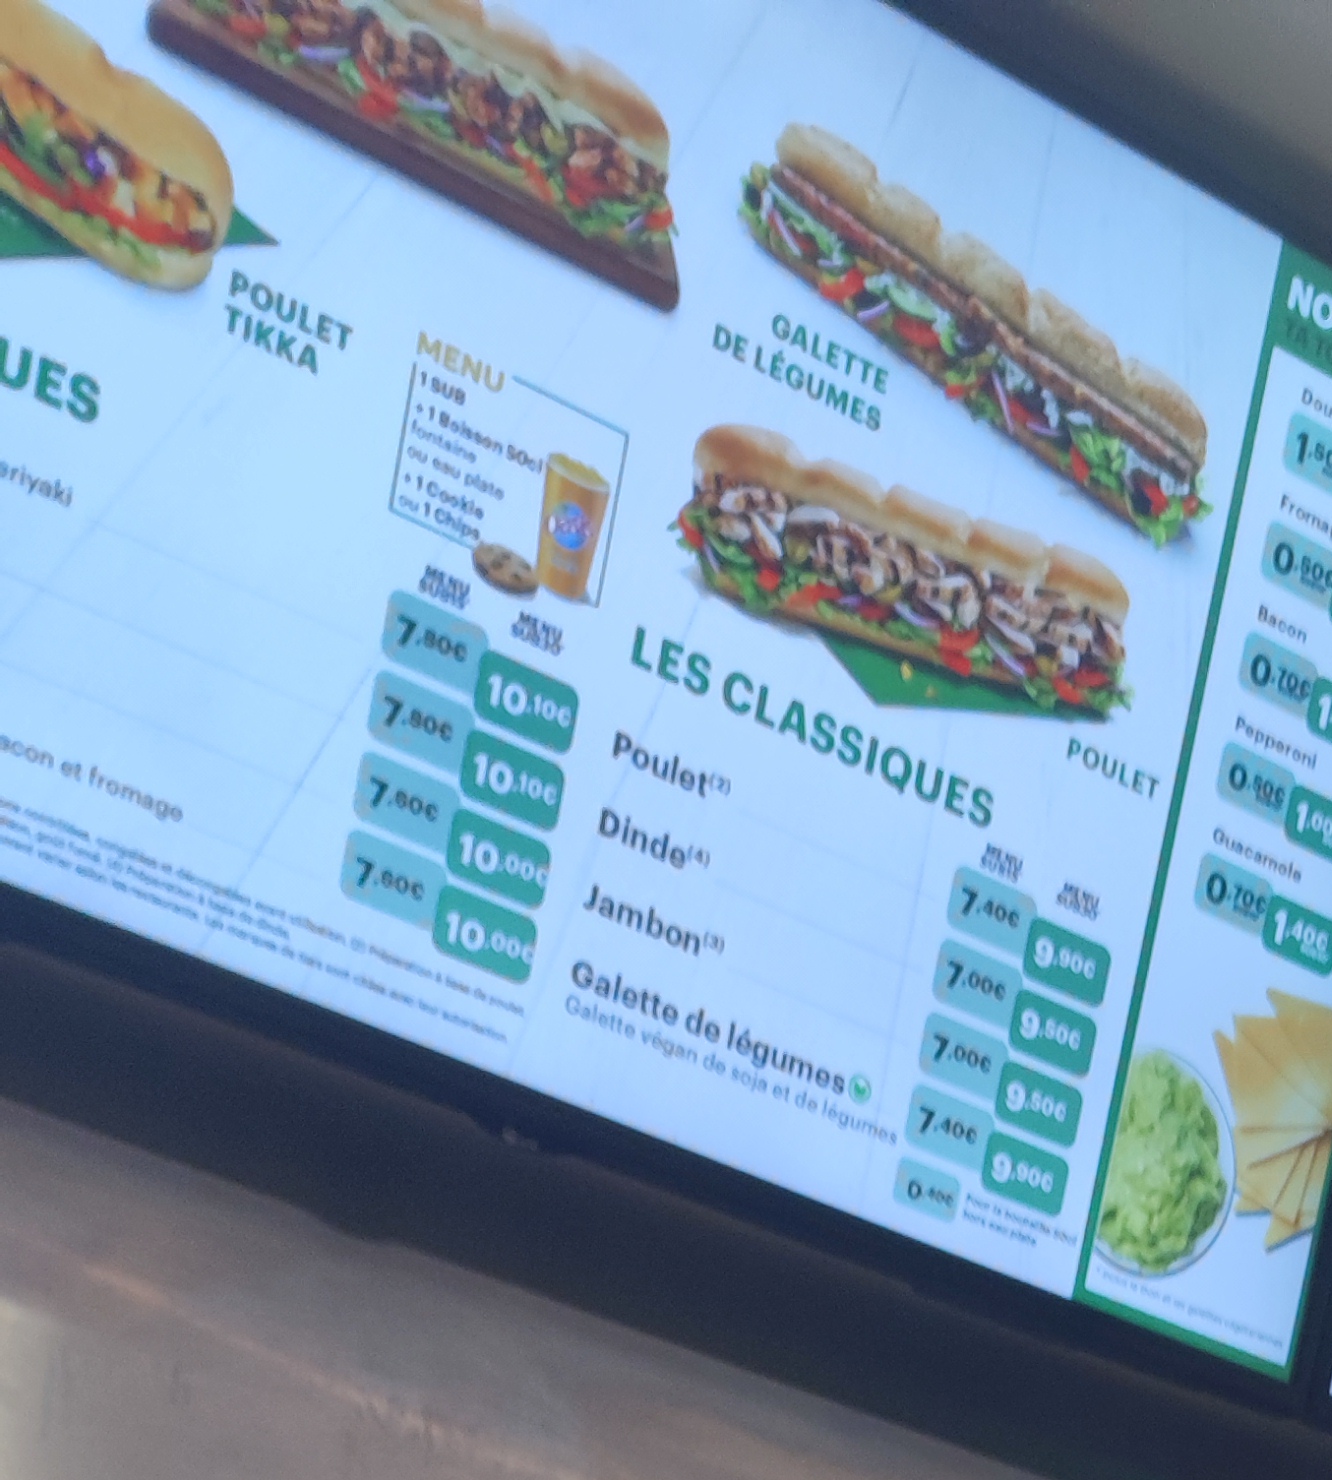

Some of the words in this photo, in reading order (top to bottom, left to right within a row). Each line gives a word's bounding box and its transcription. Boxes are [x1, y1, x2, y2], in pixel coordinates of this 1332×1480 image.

[225, 303, 318, 376] TIKKA
[229, 268, 353, 351] POULET
[417, 330, 506, 393] MENU
[712, 323, 752, 360] DE
[753, 342, 883, 433] LÉGUMES
[771, 313, 890, 395] GALETTE
[431, 376, 467, 405] SUB
[411, 419, 477, 464] fontaine
[438, 410, 504, 456] Boisson
[426, 480, 486, 521] Cookie
[433, 507, 481, 542] Chips
[1257, 605, 1308, 644] Bacon
[631, 624, 712, 696] LES
[723, 671, 994, 827] CLASSIQUES
[1234, 716, 1318, 770] Pepperoni
[61, 760, 82, 782] et
[90, 765, 183, 823] fromage
[1066, 737, 1160, 801] POULET
[1212, 827, 1302, 883] Guacamole
[570, 959, 680, 1025] Galette
[684, 1007, 722, 1045] de
[726, 1020, 846, 1096] légumes
[564, 993, 636, 1040] Galette
[641, 1029, 699, 1069] végan
[702, 1051, 727, 1078] de
[731, 1063, 769, 1096] soja
[773, 1078, 791, 1101] et
[794, 1087, 819, 1115] de
[821, 1099, 898, 1148] légumes
